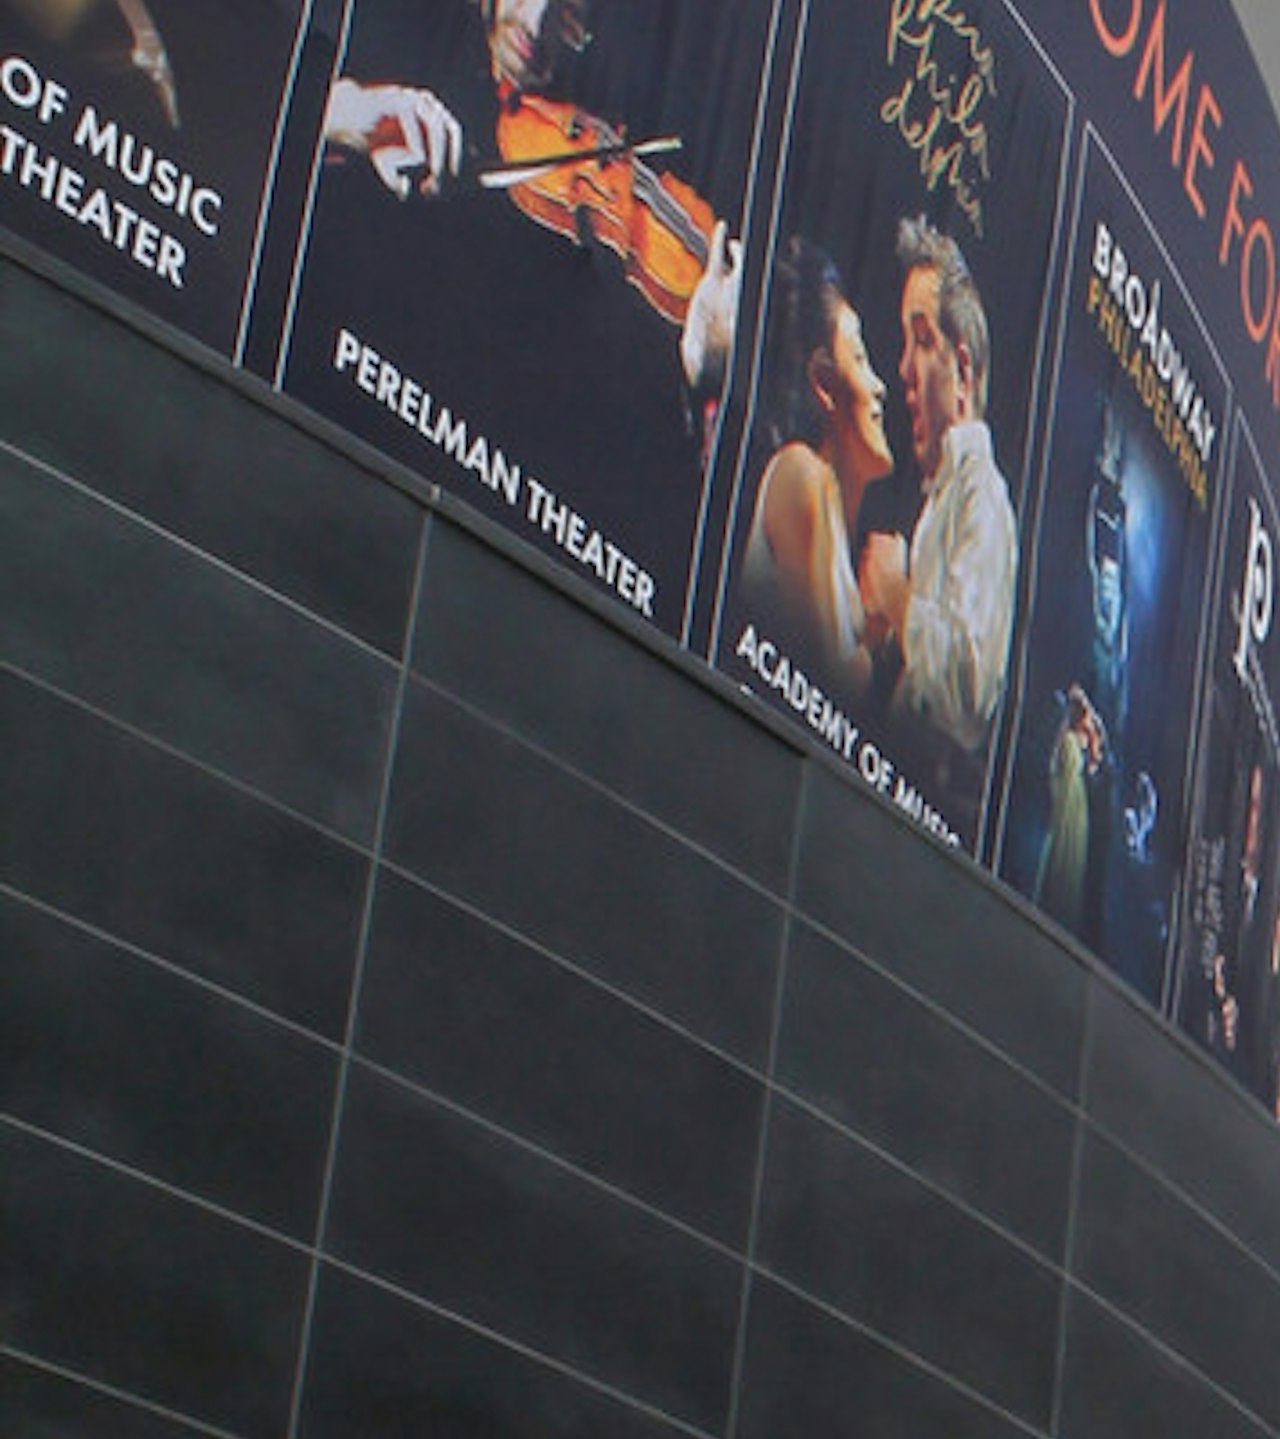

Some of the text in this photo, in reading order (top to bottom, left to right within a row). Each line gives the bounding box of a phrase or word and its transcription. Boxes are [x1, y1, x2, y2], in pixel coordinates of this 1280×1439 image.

[0, 58, 222, 236] OF MUSIC
[0, 125, 187, 288] THEATER
[1086, 276, 1207, 509] PHILADELPHIA
[1093, 220, 1216, 462] BROADWAY
[334, 328, 655, 617] PERELMAN THEATER
[736, 623, 859, 760] ACADEMY
[859, 742, 895, 793] OF
